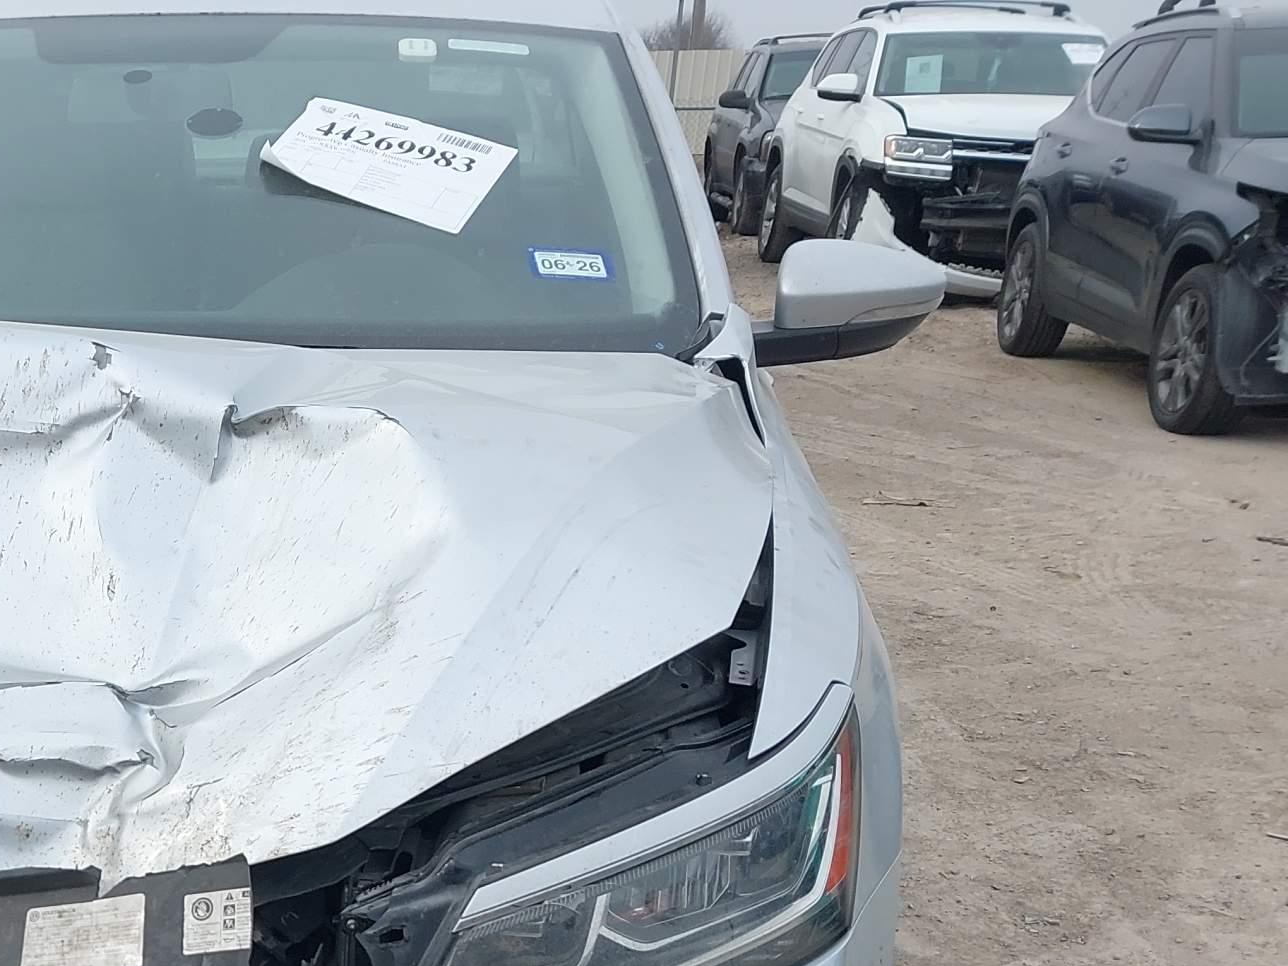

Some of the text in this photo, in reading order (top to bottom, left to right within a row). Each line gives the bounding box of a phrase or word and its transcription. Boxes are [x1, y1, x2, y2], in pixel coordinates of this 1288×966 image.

[316, 121, 477, 173] 44269983
[541, 258, 601, 273] 06 26
